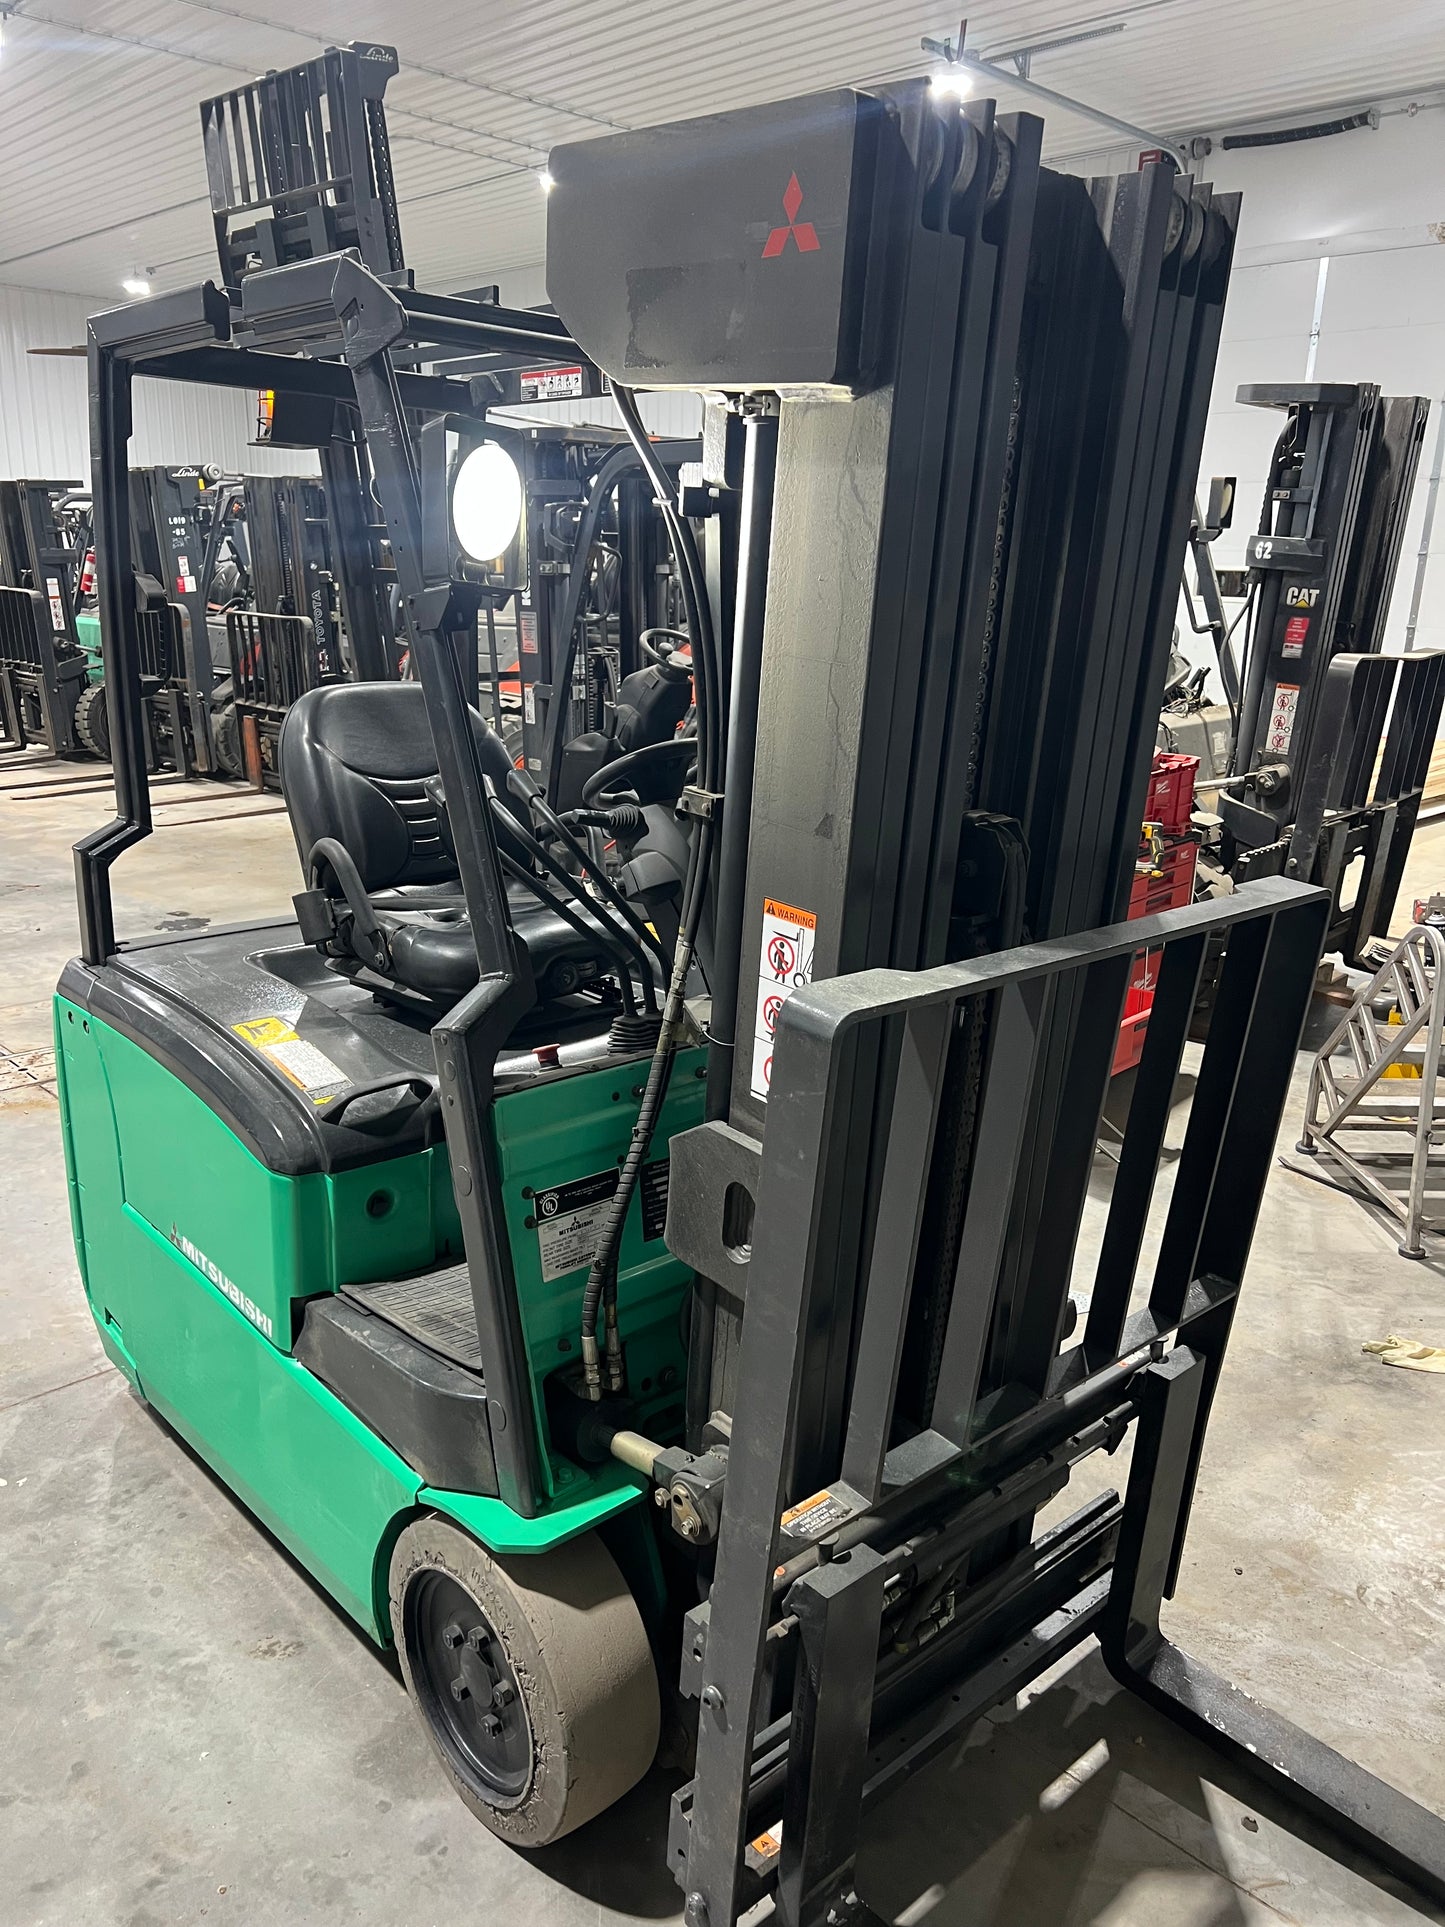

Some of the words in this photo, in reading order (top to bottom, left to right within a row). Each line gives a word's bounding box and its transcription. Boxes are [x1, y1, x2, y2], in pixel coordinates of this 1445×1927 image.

[171, 467, 200, 477] Linde
[1255, 541, 1273, 559] 62
[1286, 586, 1320, 608] CAT
[311, 590, 326, 645] TOYOTA
[777, 908, 814, 928] WARNING
[558, 1219, 594, 1236] MITSUBISHI
[182, 1236, 273, 1338] MITSUBISHI
